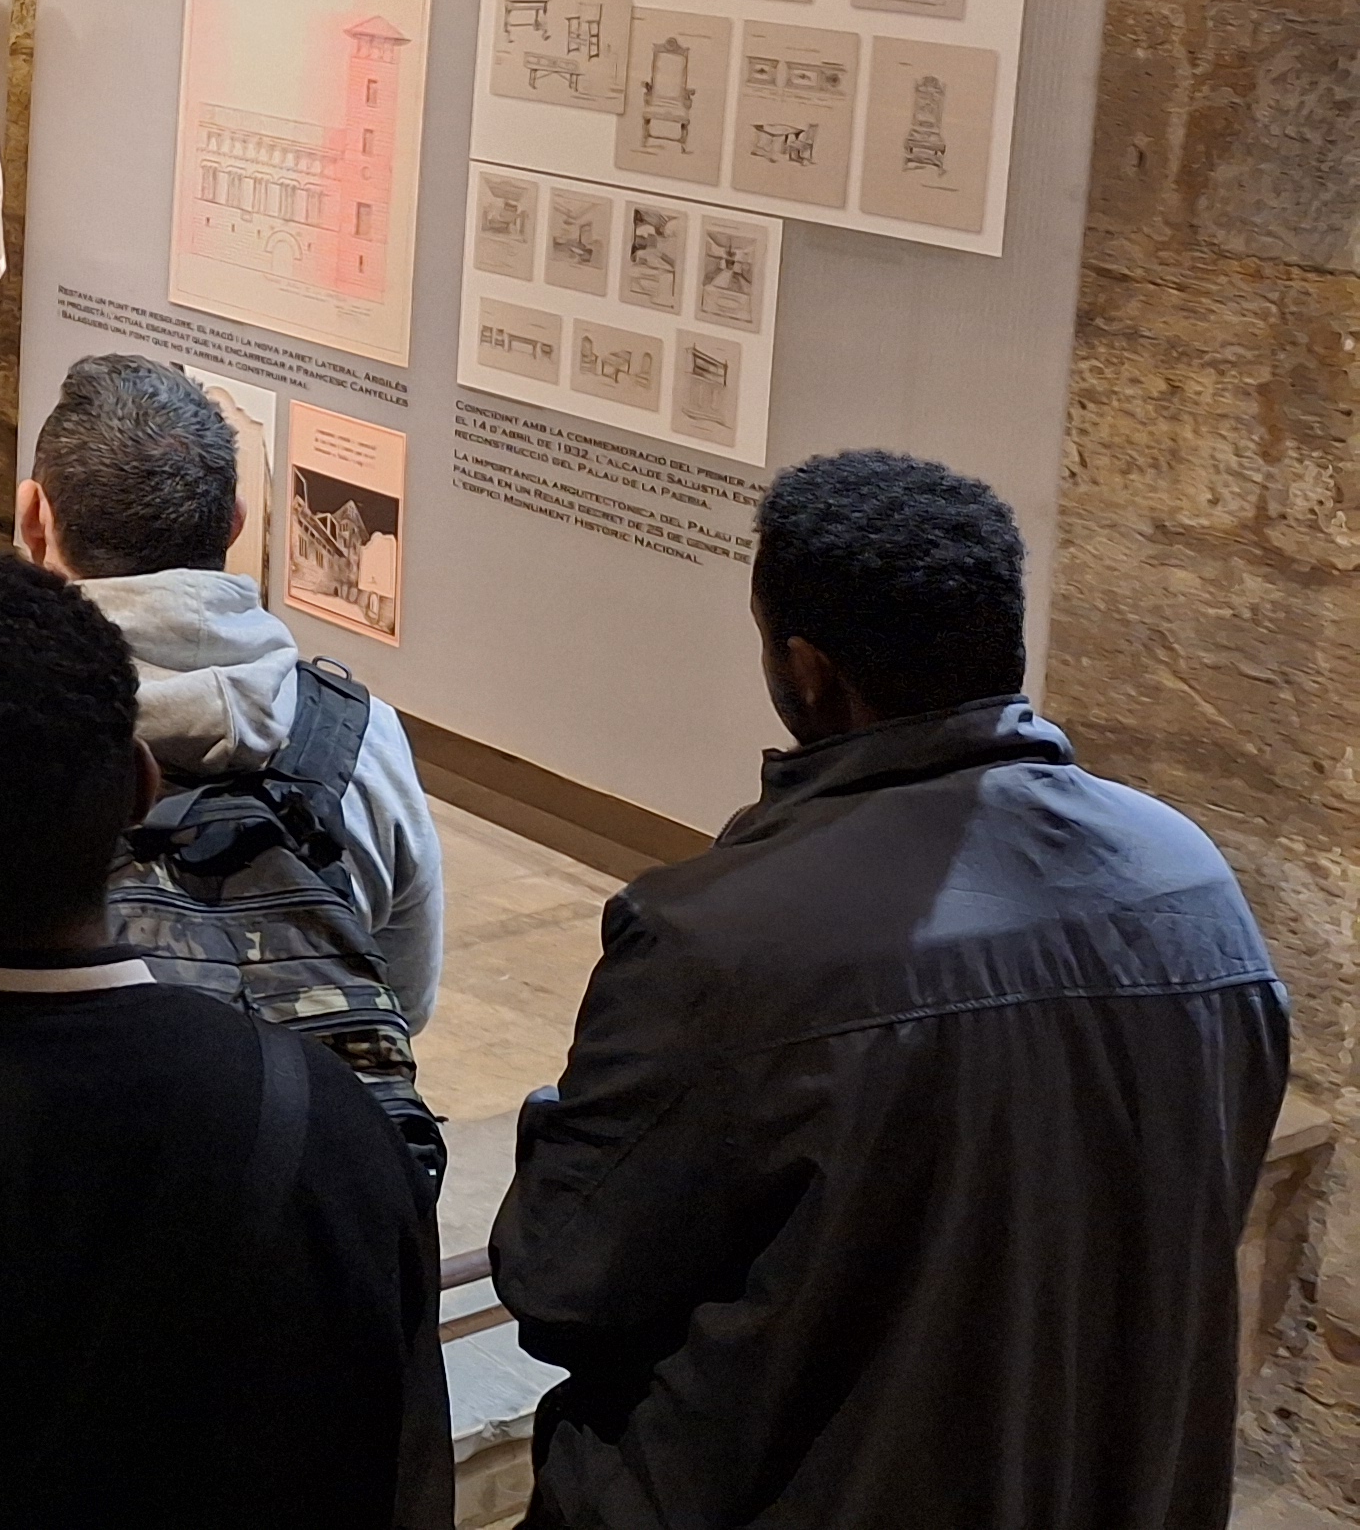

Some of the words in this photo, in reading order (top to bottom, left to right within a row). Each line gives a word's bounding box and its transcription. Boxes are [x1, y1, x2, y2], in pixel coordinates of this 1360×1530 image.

[282, 349, 312, 363] PARET
[456, 400, 519, 425] COINCIDINT
[522, 420, 546, 433] AMB
[550, 428, 564, 438] LA
[456, 415, 468, 426] EL
[474, 419, 486, 431] 14
[455, 449, 468, 462] LA
[660, 514, 684, 529] DEL
[498, 479, 512, 490] EN
[578, 463, 618, 482] PALAU
[622, 477, 638, 489] DE
[642, 483, 656, 494] LA
[635, 535, 702, 565] NACIONAL
